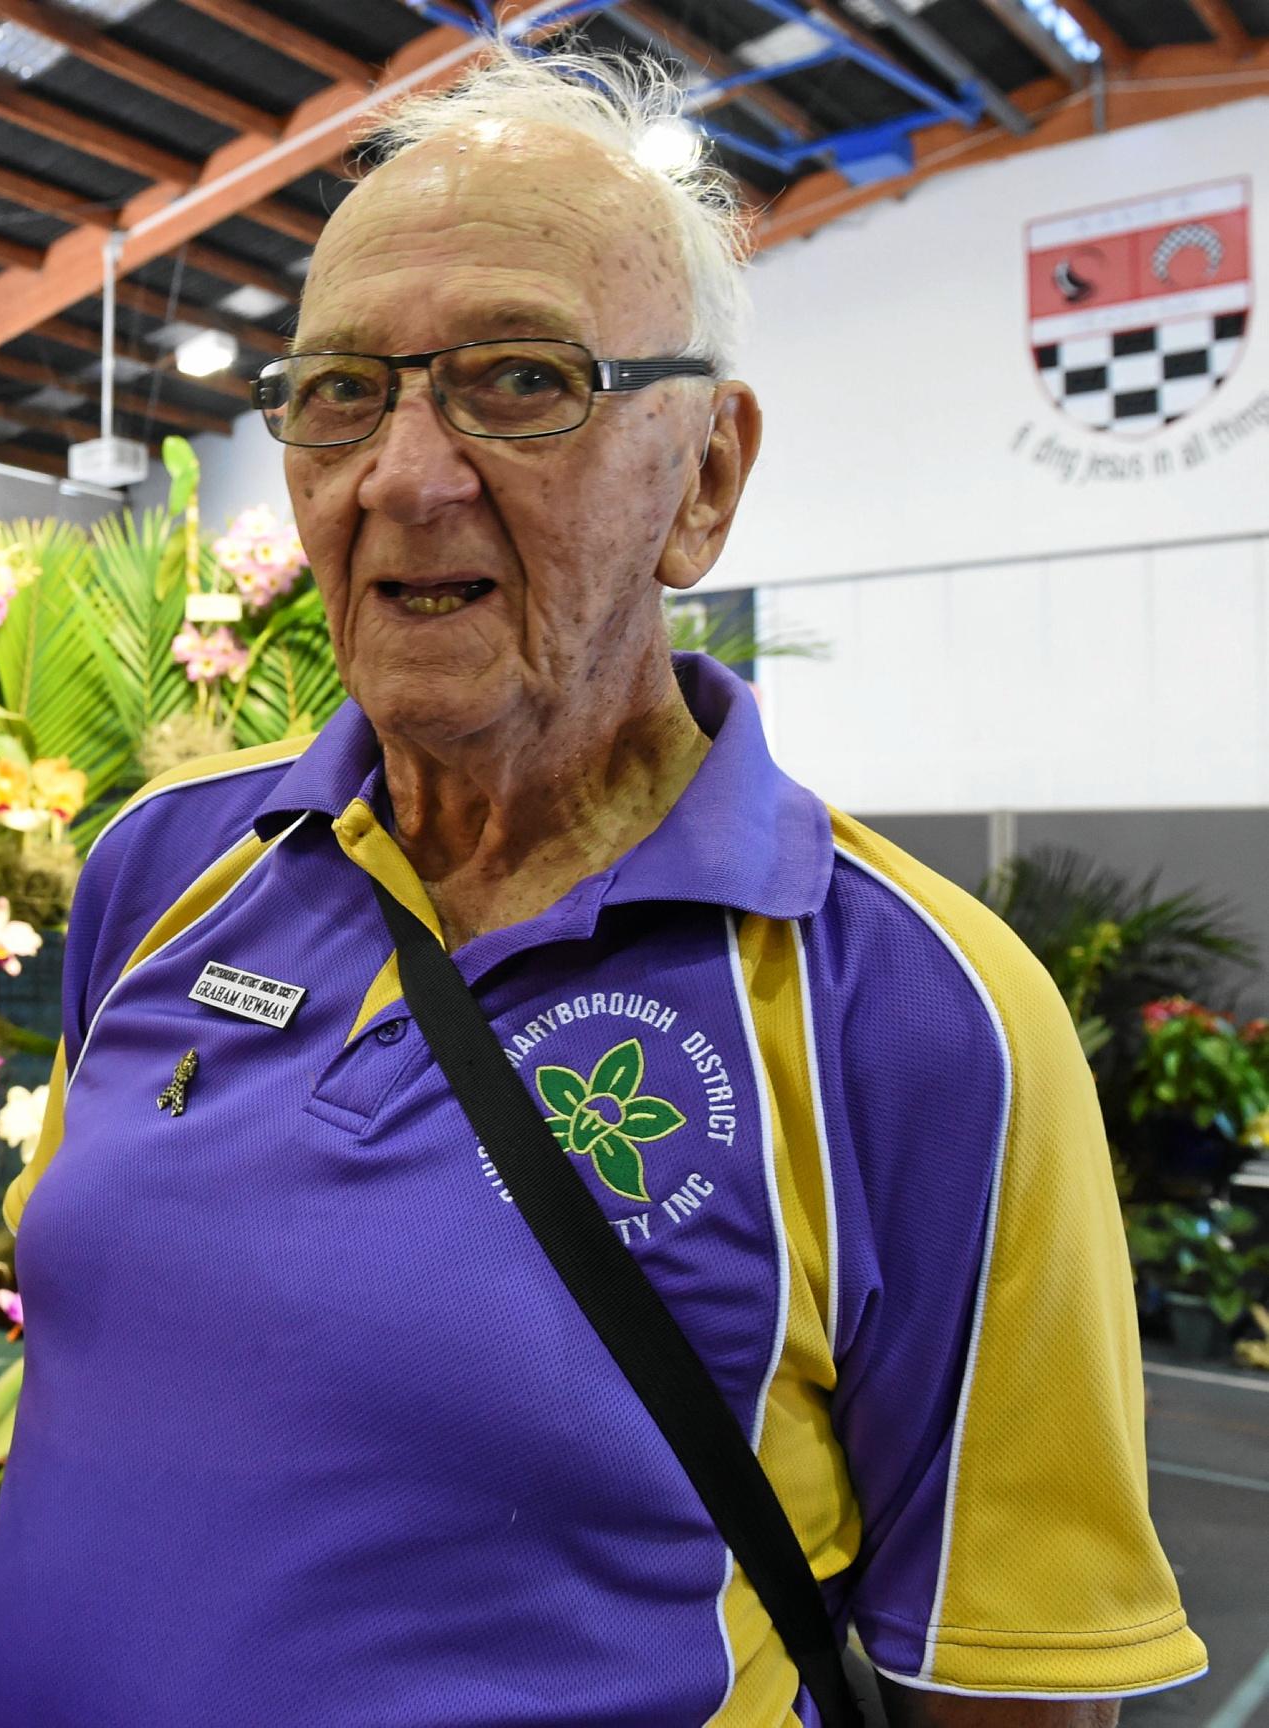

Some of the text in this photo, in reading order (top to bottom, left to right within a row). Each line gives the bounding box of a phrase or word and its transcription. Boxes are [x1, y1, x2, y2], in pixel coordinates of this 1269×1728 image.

[195, 980, 290, 1021] GRAHAM NEWMAN
[680, 1030, 736, 1147] DISTRICT
[660, 1172, 715, 1224] INC
